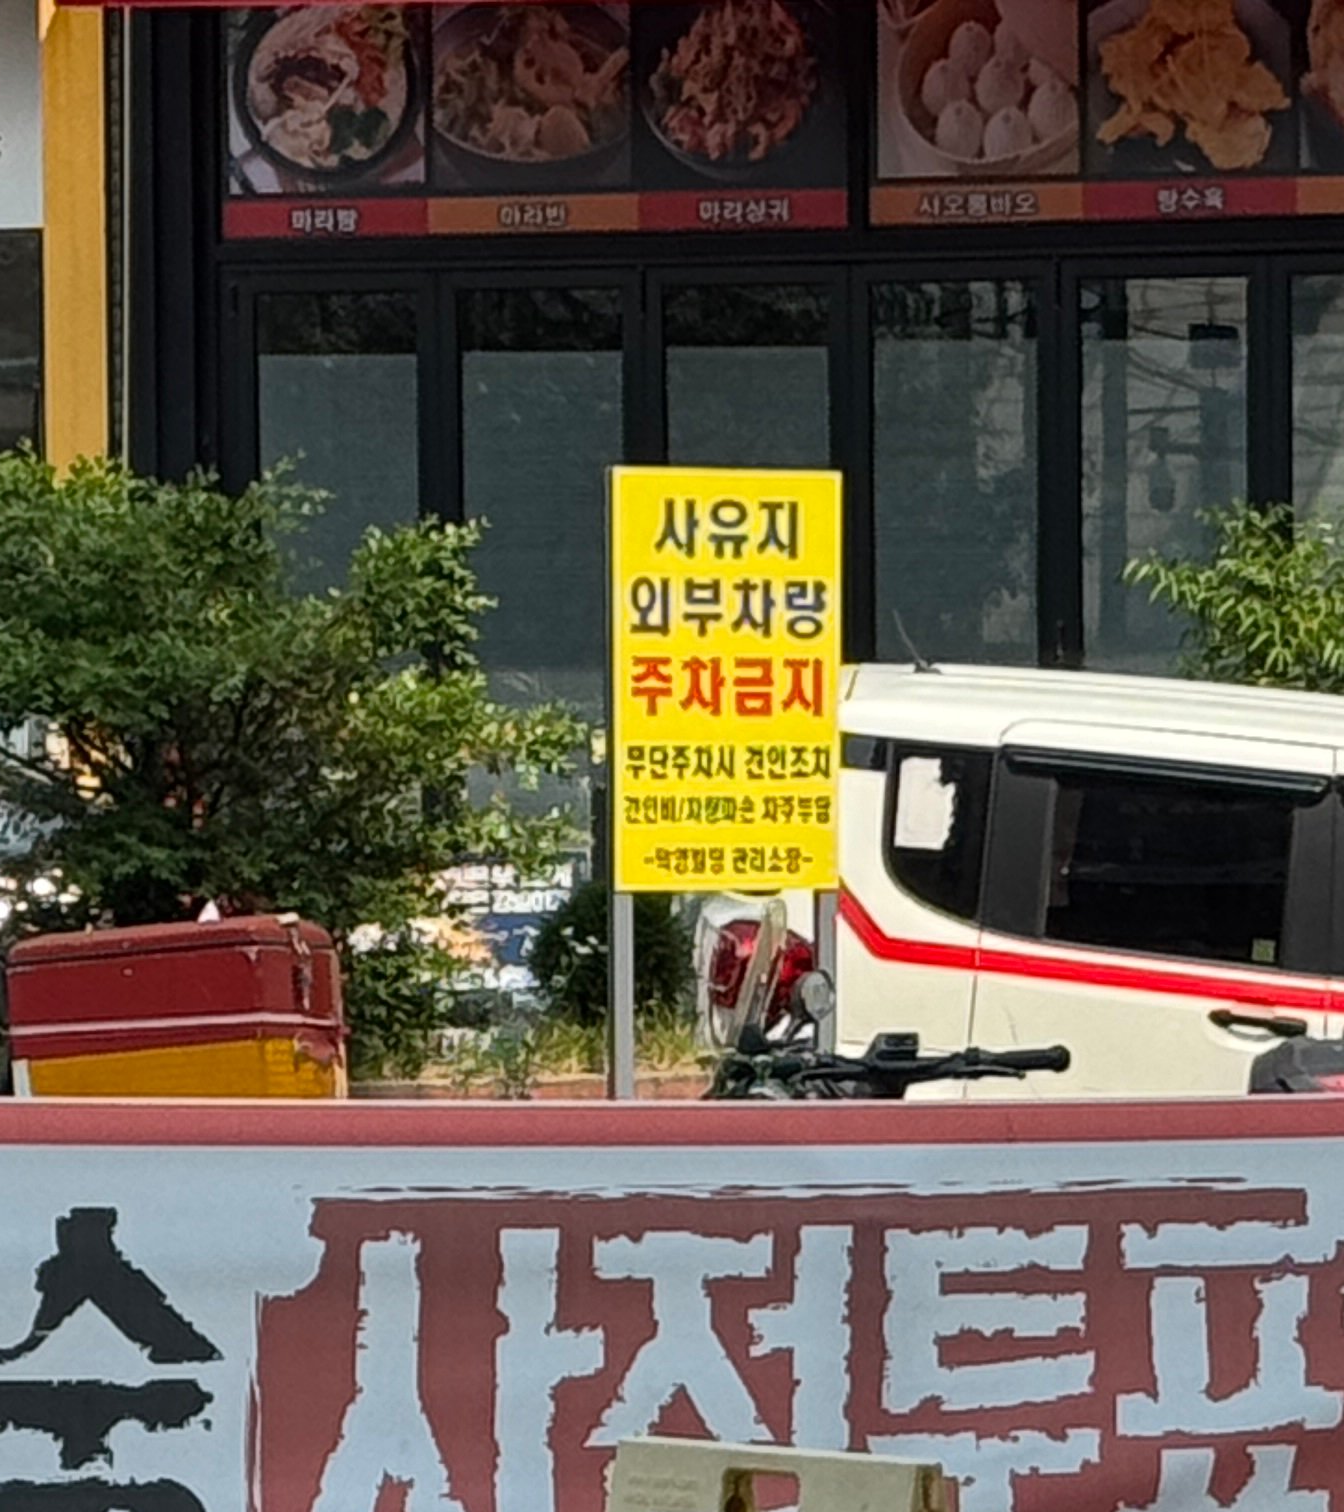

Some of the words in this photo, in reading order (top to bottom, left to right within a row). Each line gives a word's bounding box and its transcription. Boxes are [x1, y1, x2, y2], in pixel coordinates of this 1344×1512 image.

[655, 497, 800, 560] 사유지
[629, 576, 828, 640] 외부차량
[630, 655, 825, 718] 주차금지
[625, 744, 736, 781] 무단주차시
[744, 744, 832, 780] 견인조치
